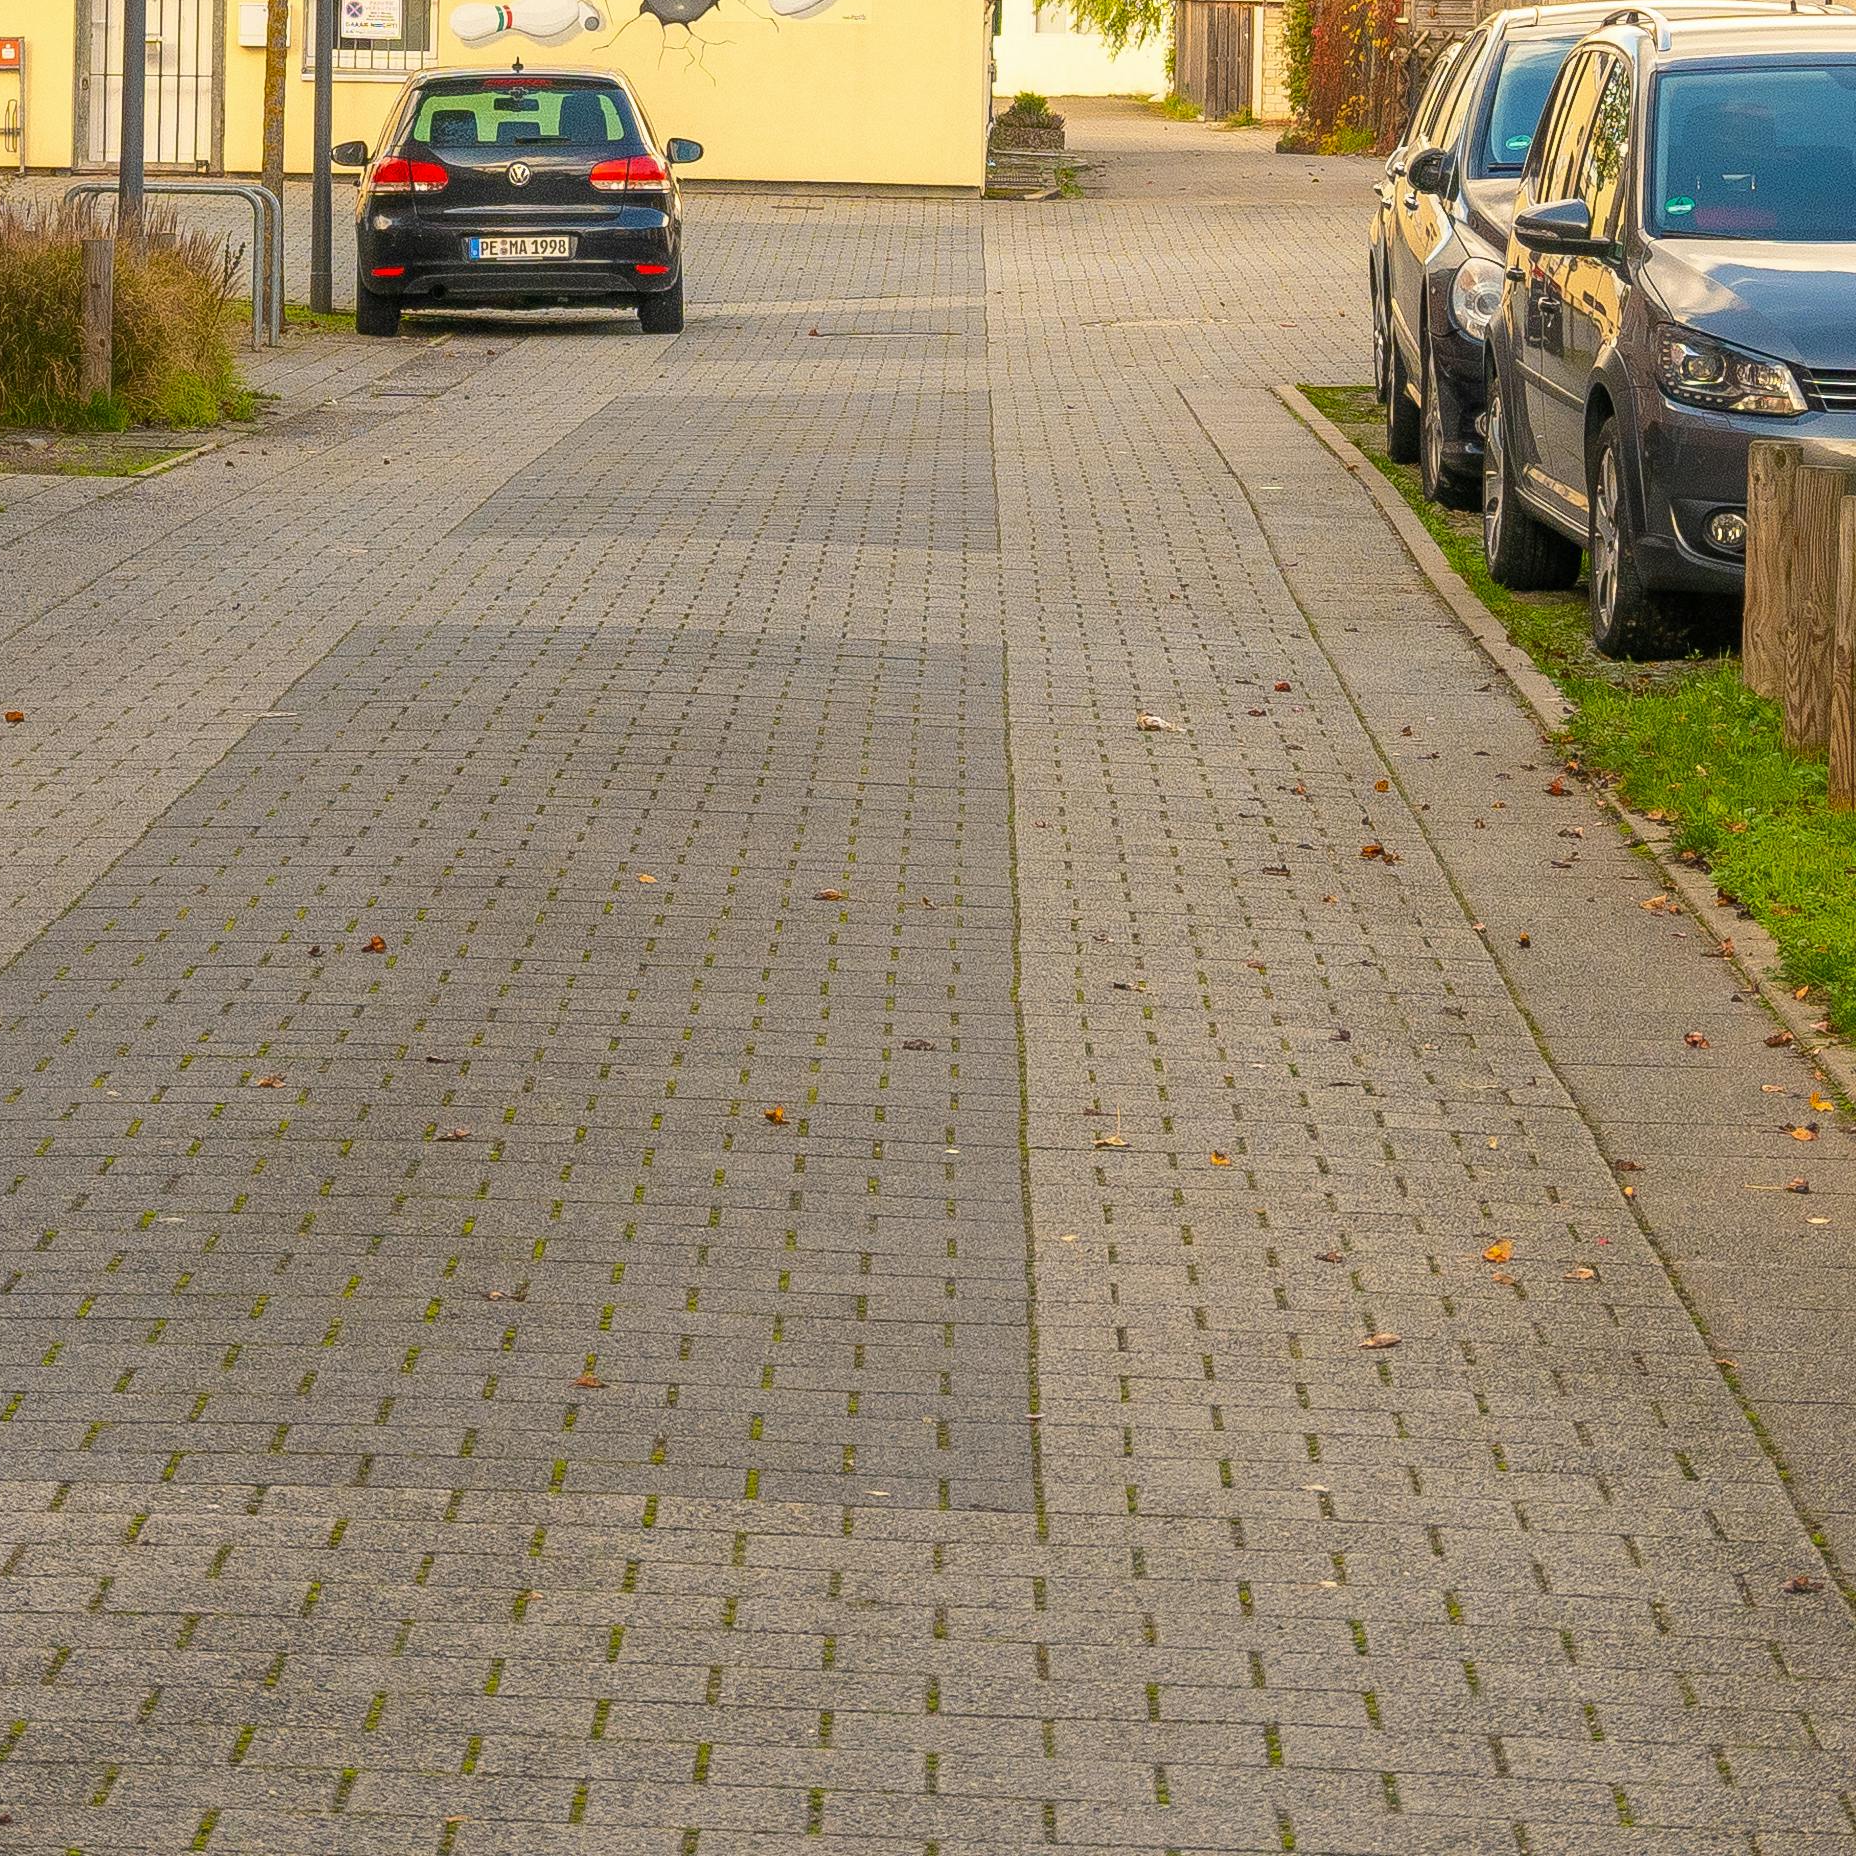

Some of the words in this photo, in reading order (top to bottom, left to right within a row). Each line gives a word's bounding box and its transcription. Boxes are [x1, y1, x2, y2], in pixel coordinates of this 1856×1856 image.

[480, 240, 499, 256] PE
[509, 239, 528, 255] MA
[530, 239, 567, 255] 1998
